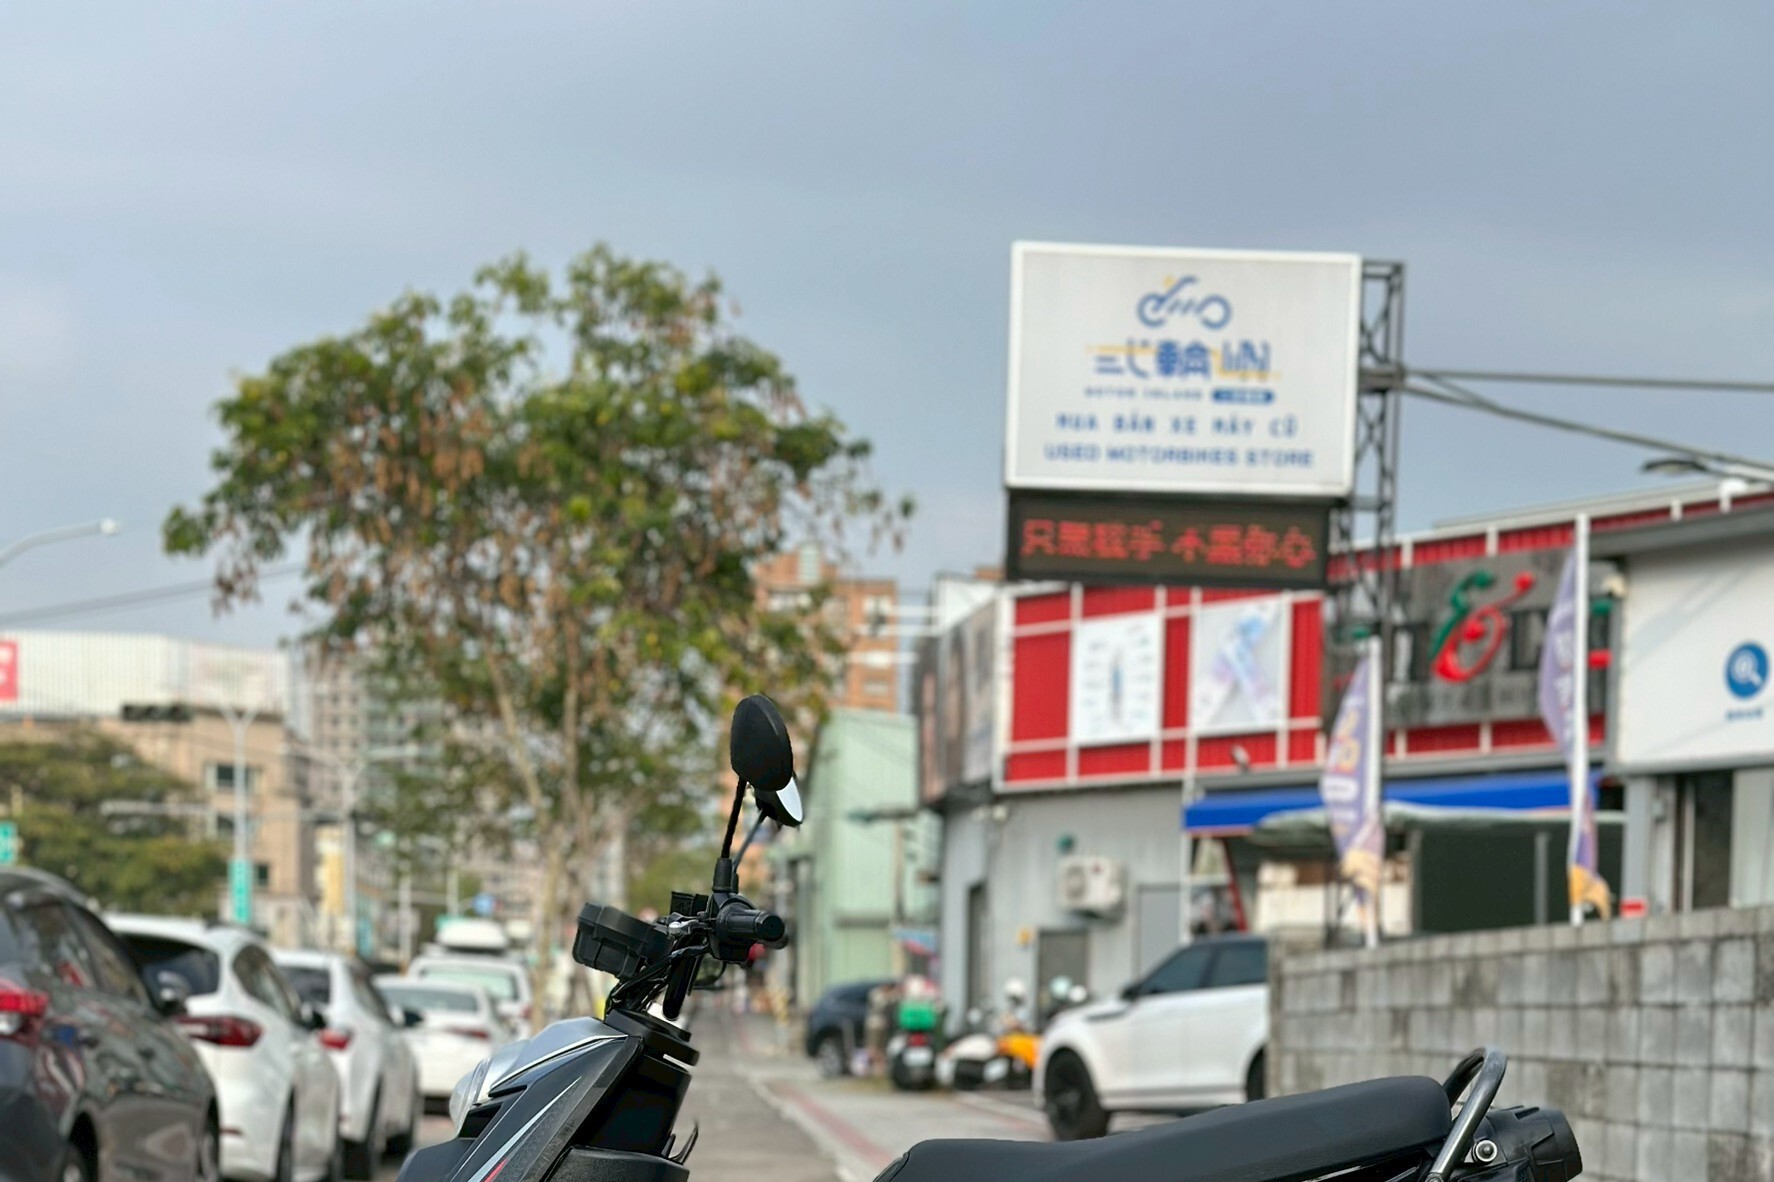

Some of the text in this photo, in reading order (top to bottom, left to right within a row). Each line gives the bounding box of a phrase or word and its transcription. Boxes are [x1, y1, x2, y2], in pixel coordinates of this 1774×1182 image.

[1044, 442, 1314, 469] USED MOTORBIKES STORE
